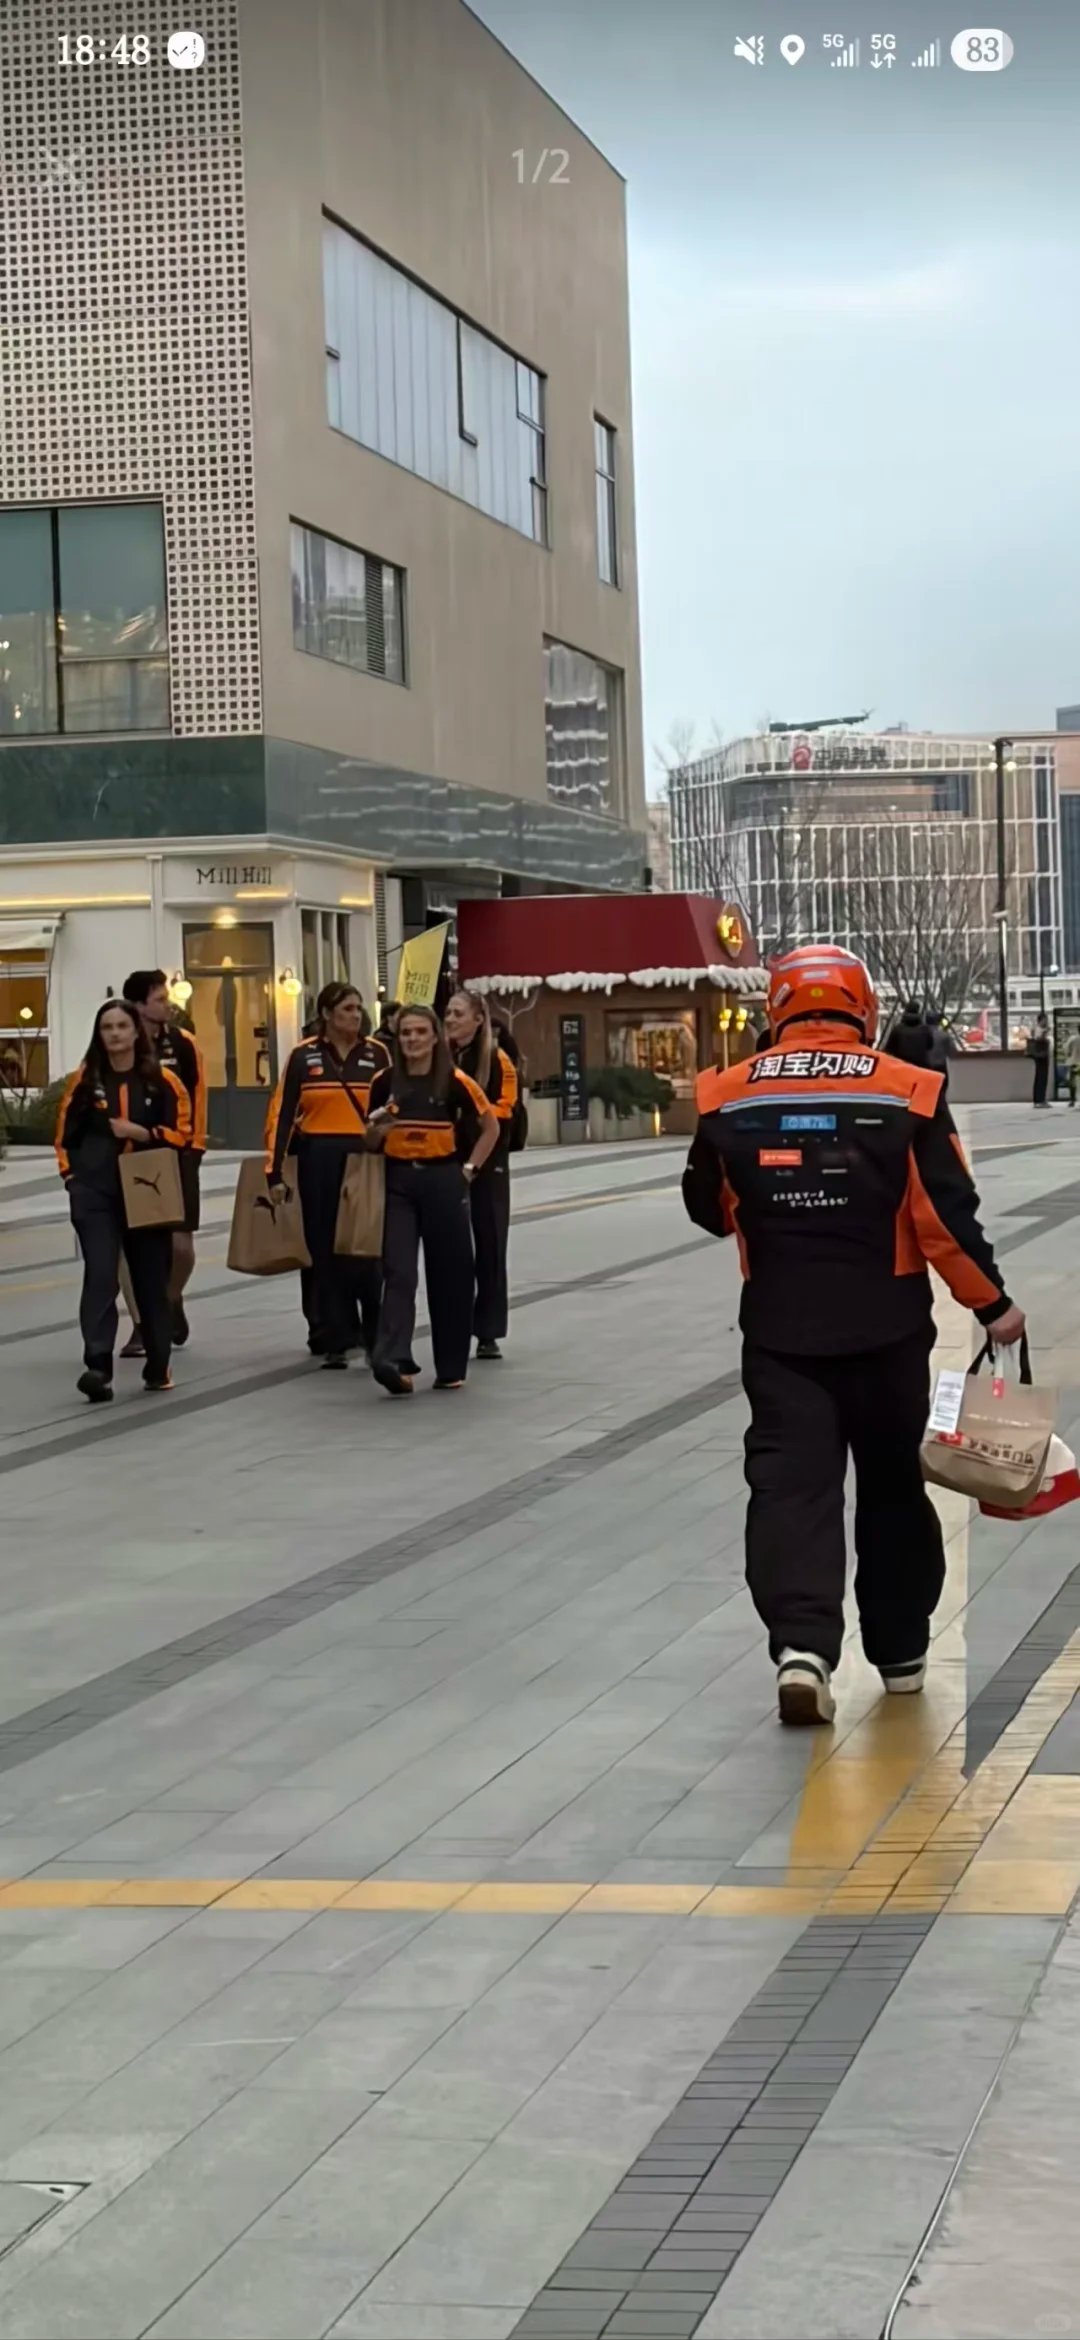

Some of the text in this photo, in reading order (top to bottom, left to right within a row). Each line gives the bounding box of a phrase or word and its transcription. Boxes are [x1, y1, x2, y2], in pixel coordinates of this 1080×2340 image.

[196, 866, 272, 885] Mill Hill
[751, 1051, 875, 1081] 淘宝闪购
